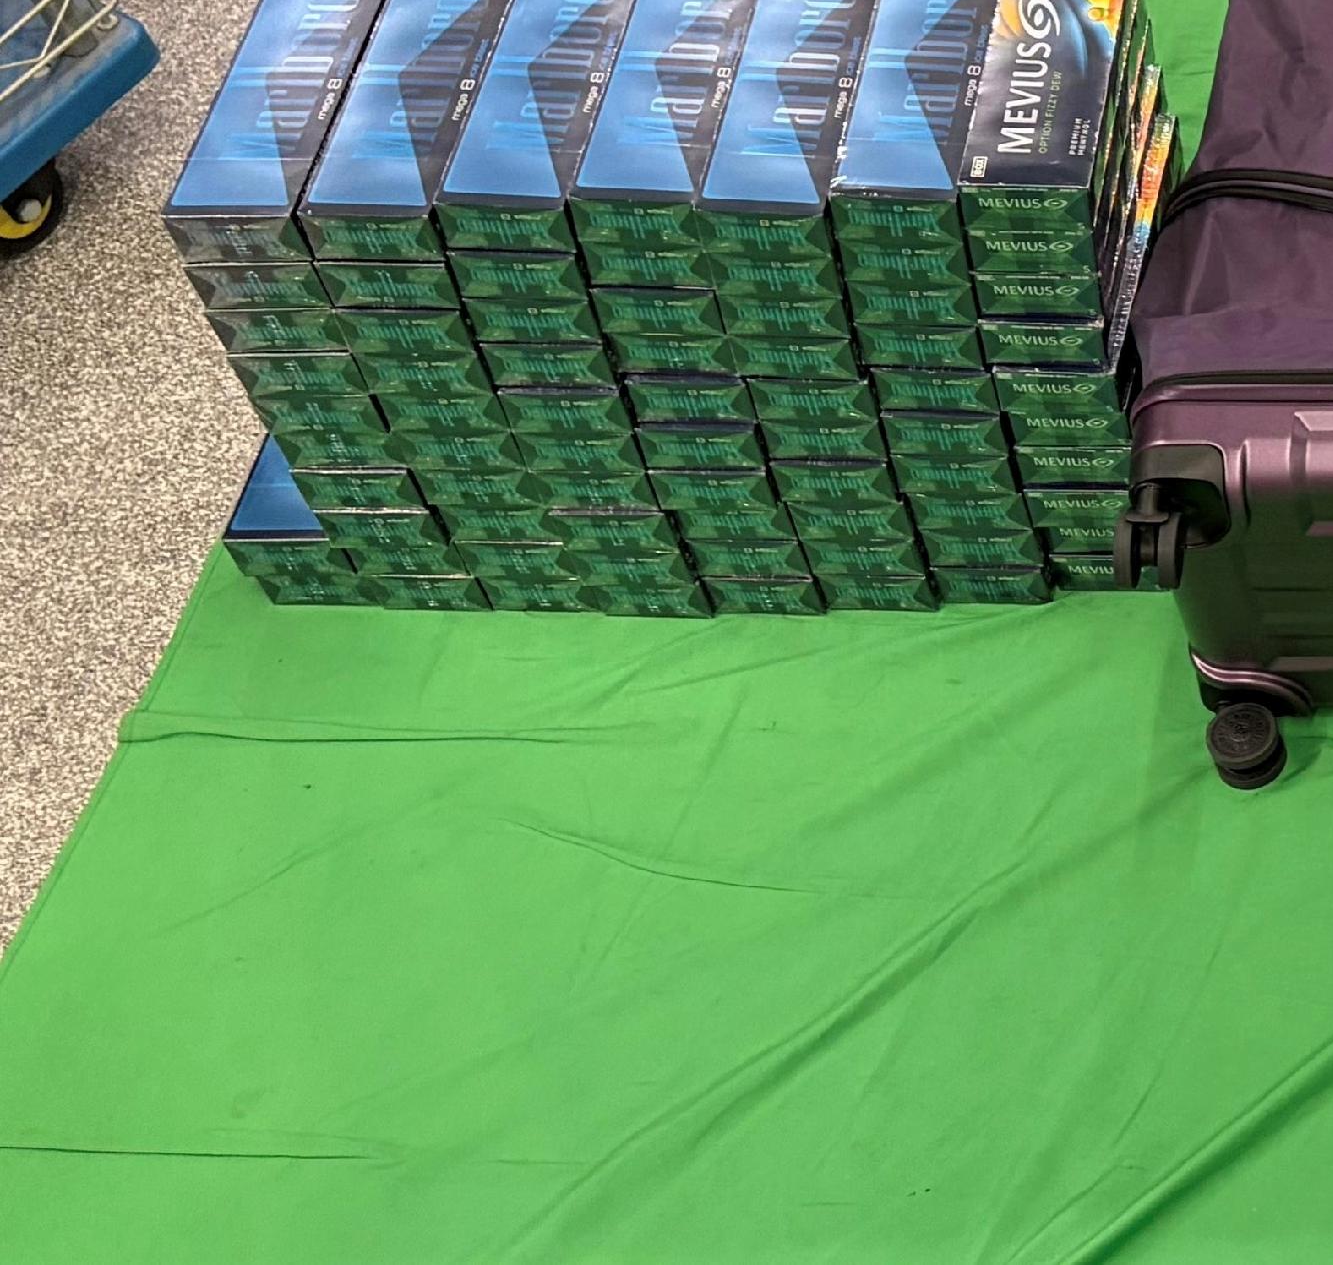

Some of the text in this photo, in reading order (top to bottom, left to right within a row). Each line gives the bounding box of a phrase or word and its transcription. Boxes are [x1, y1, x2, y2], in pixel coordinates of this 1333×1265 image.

[583, 86, 598, 112] mega
[711, 80, 727, 107] mega
[835, 91, 847, 118] mega
[965, 79, 977, 106] mega
[998, 42, 1051, 154] MEVIUS
[318, 93, 335, 120] mega
[452, 94, 468, 121] mega
[1039, 71, 1063, 154] OPTION FIZZY DEW
[1069, 118, 1082, 156] PREMIUM
[1078, 119, 1091, 156] MENTHOL
[978, 197, 1043, 210] MEVIUS
[986, 240, 1048, 253] MEVIUS
[994, 284, 1056, 297] MEVIUS
[999, 335, 1058, 347] MEVIUS
[1013, 382, 1072, 394] MEVIUS
[1034, 456, 1091, 468] MEVIUS
[1043, 497, 1099, 509] MEVIUS
[1069, 564, 1114, 575] MEVIU
